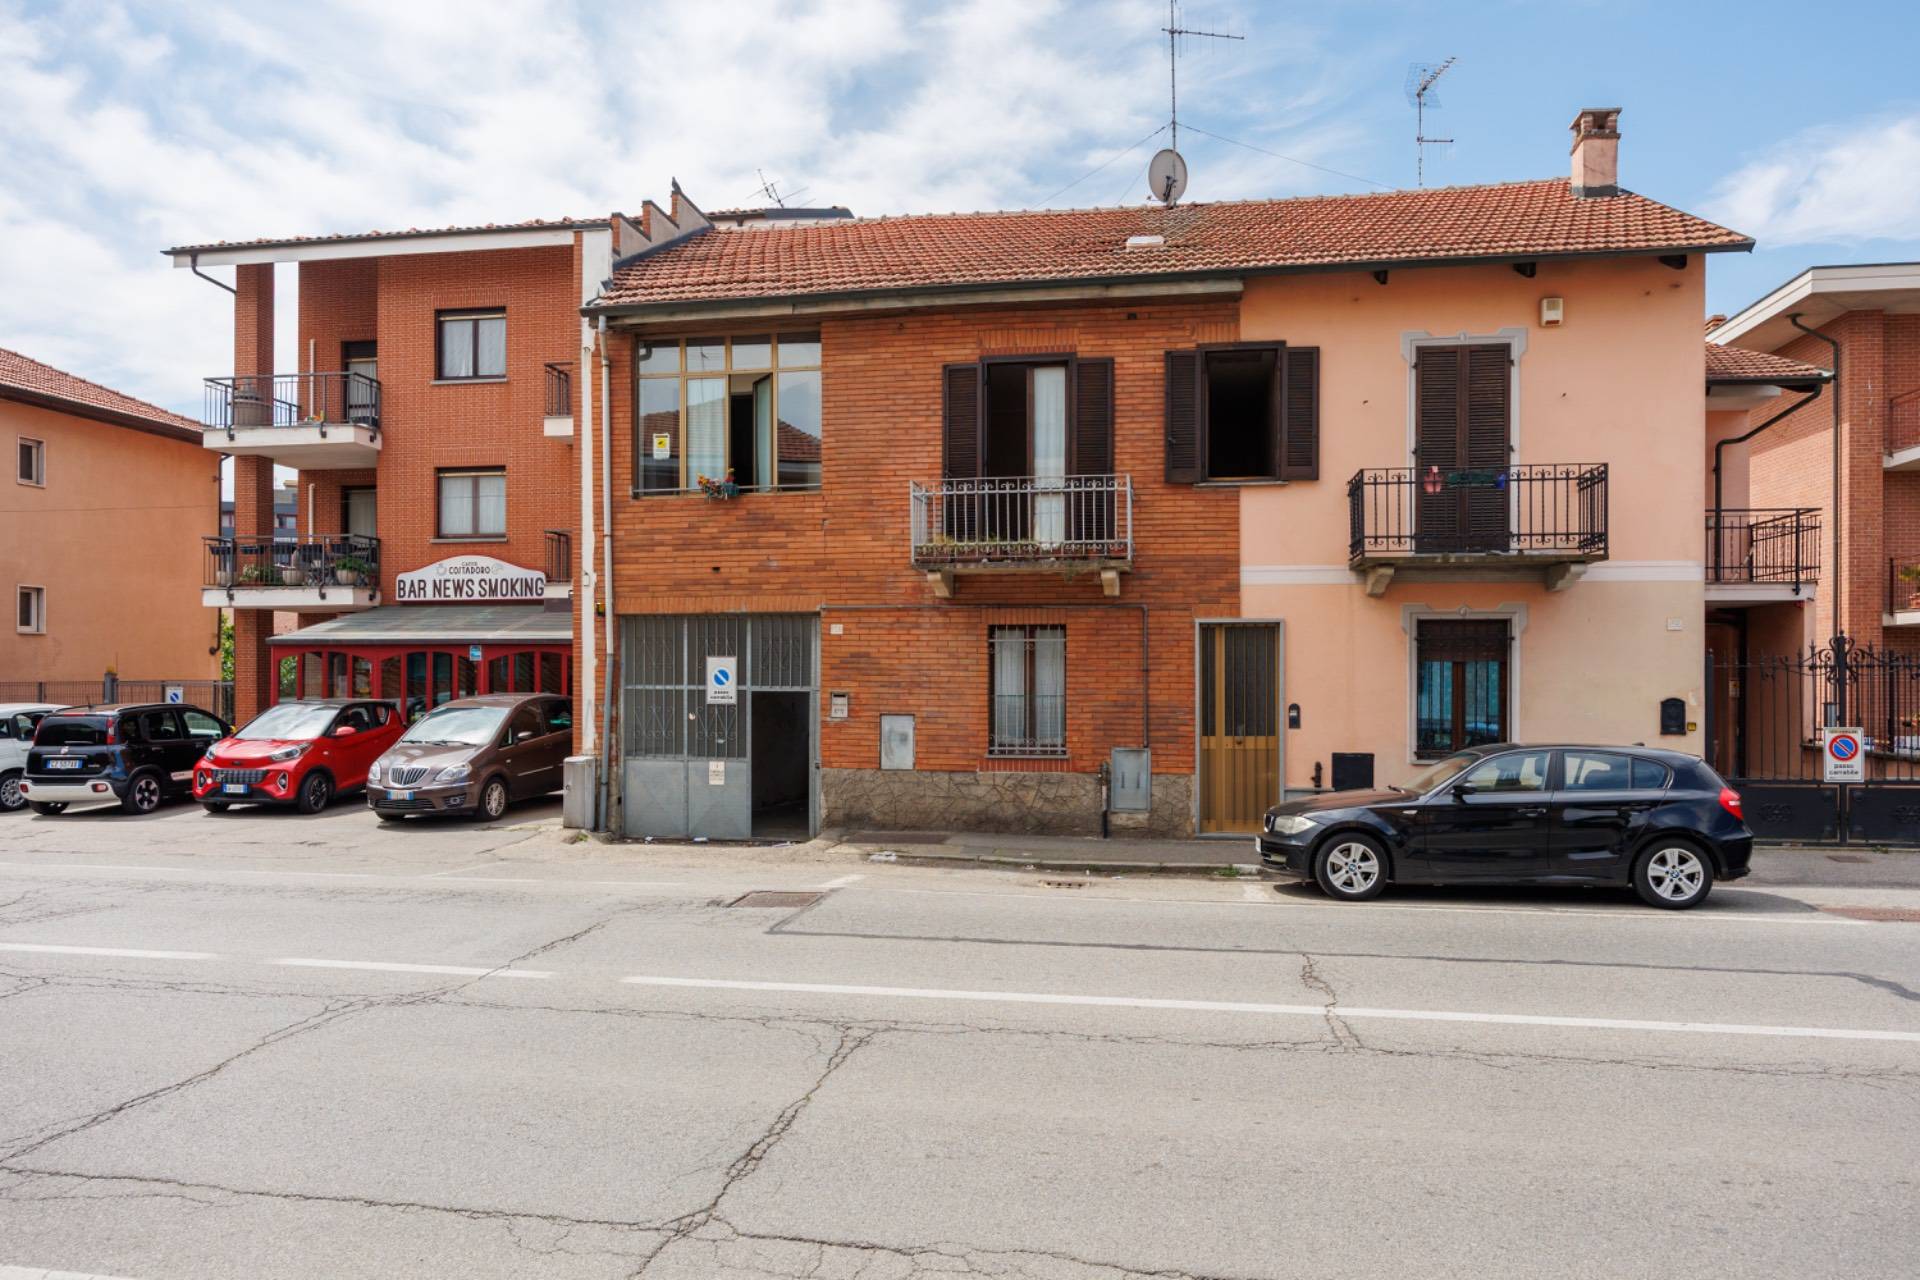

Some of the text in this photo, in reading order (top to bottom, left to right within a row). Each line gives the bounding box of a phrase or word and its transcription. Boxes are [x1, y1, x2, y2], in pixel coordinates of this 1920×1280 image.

[397, 577, 545, 599] BAR NEWS SMOKING
